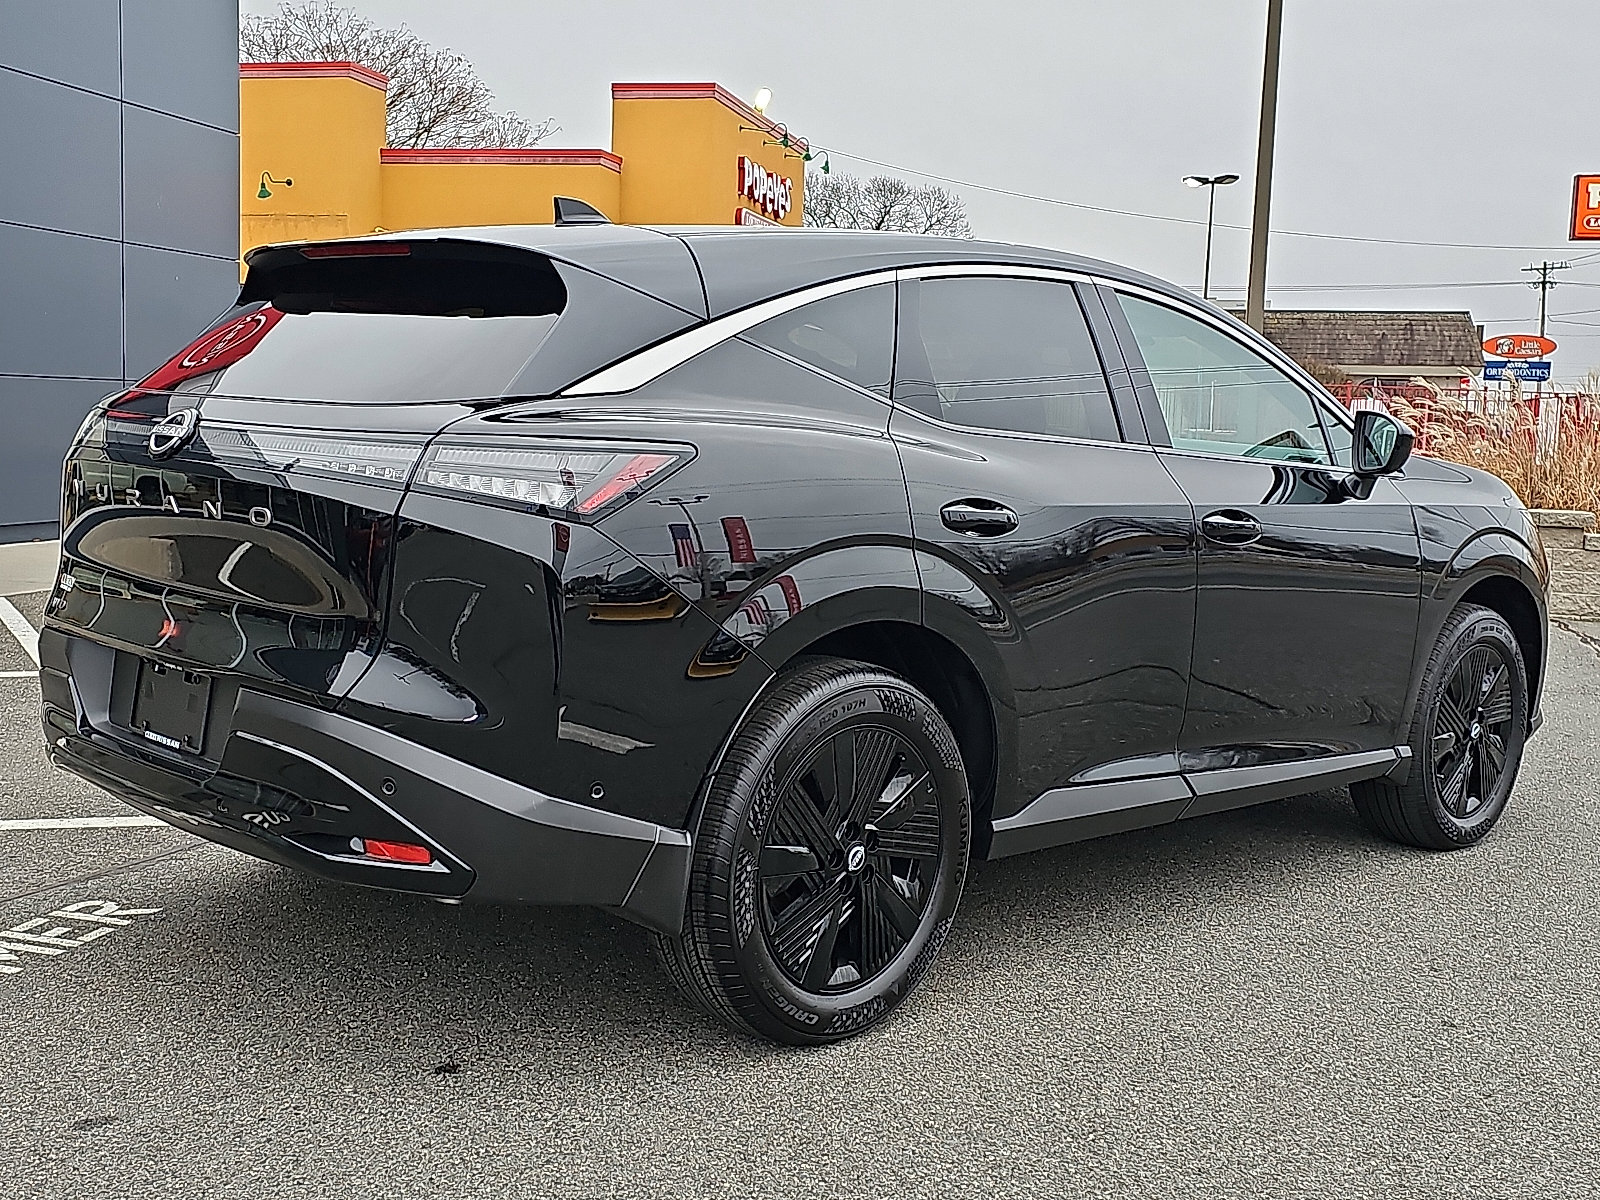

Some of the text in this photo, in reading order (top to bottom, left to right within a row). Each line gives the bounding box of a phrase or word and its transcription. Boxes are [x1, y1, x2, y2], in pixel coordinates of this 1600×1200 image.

[1521, 340, 1540, 349] Little
[1486, 368, 1549, 378] ORTDONTICS
[842, 698, 867, 714] 107H
